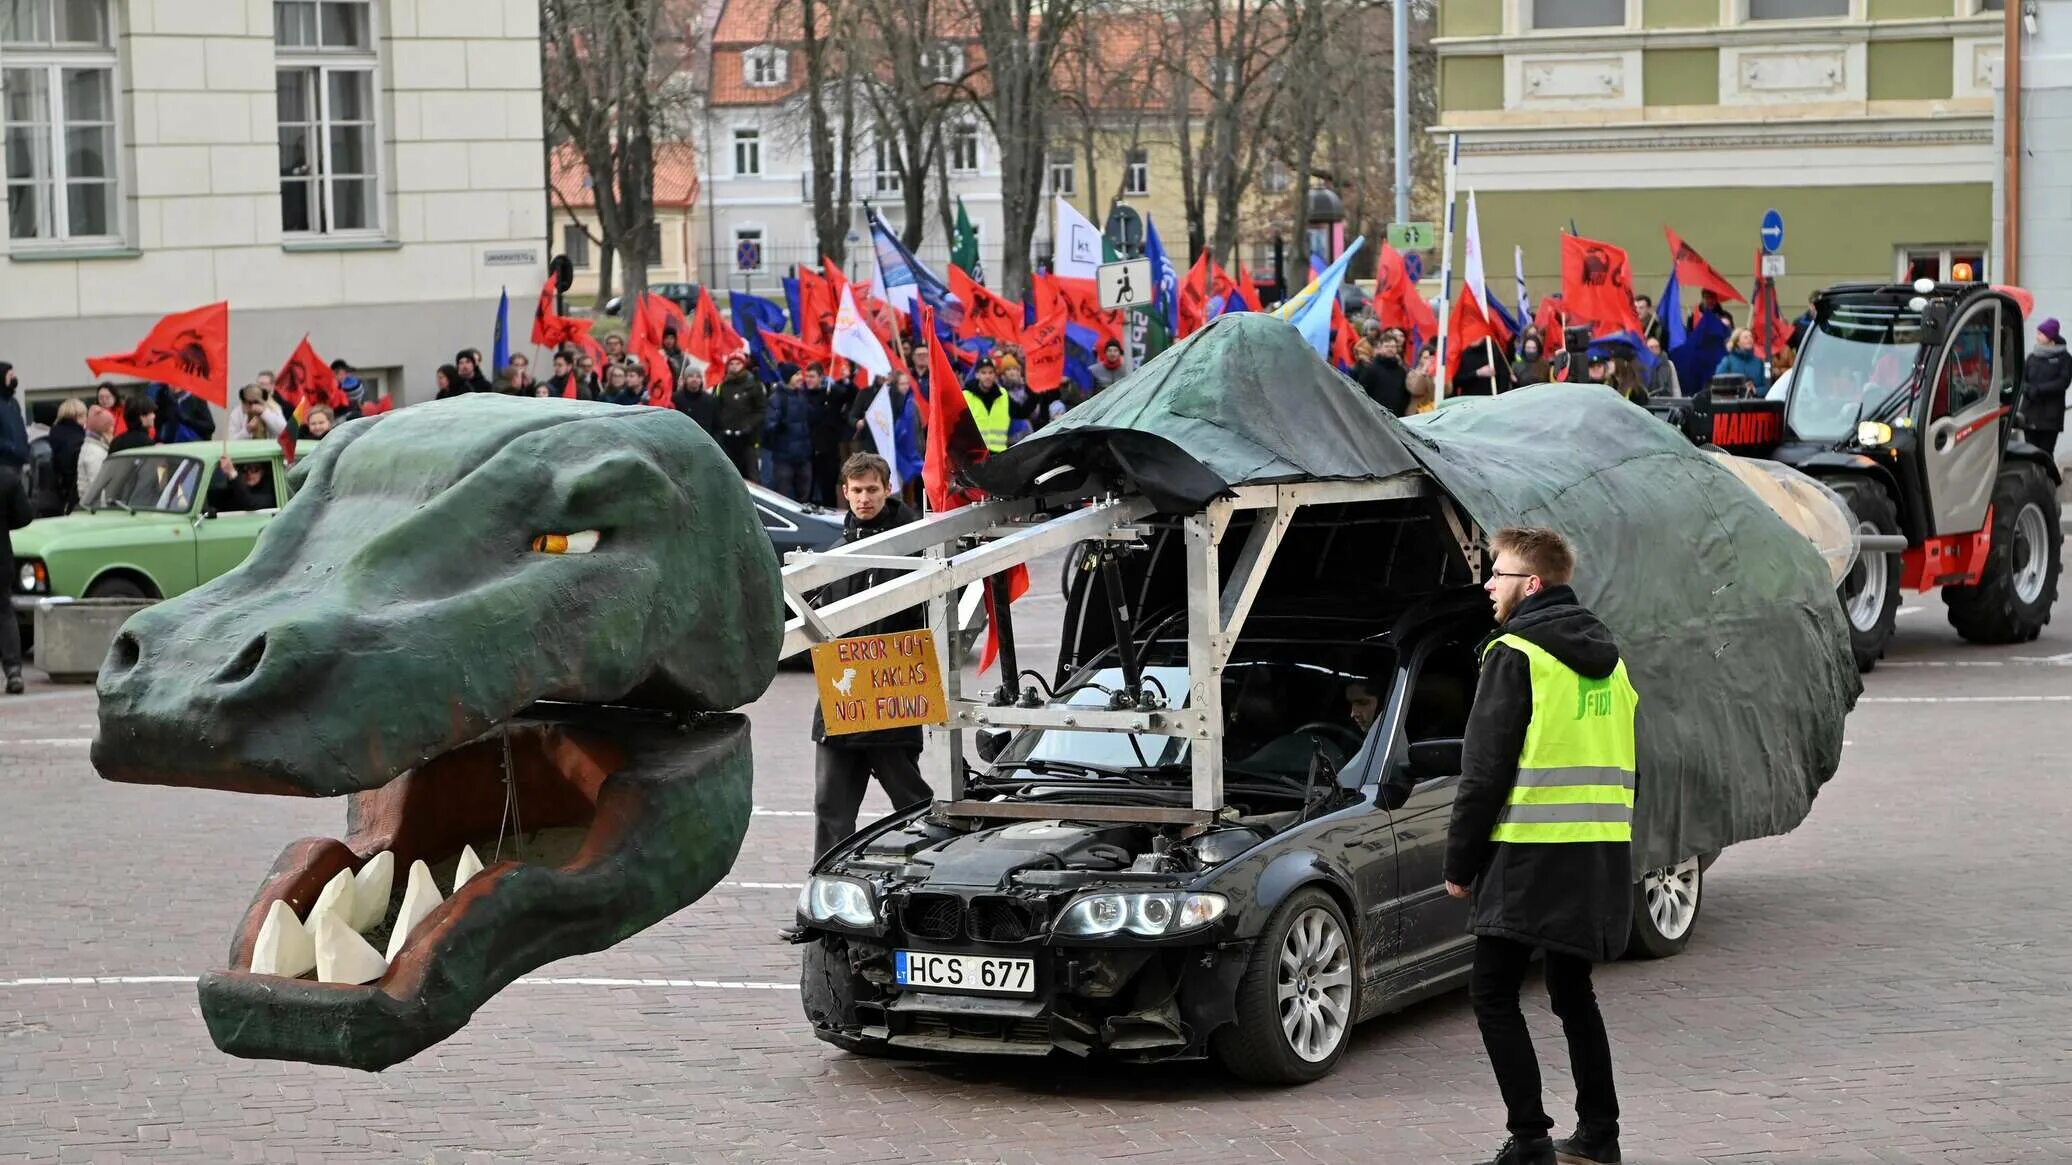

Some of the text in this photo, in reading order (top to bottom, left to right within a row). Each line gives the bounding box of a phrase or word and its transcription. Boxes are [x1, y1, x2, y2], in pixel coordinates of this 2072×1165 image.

[838, 634, 924, 663] ERROR 404
[870, 662, 928, 688] KAKLAS
[835, 694, 928, 721] NOT FOUND
[896, 955, 1030, 988] LT HCS 677
